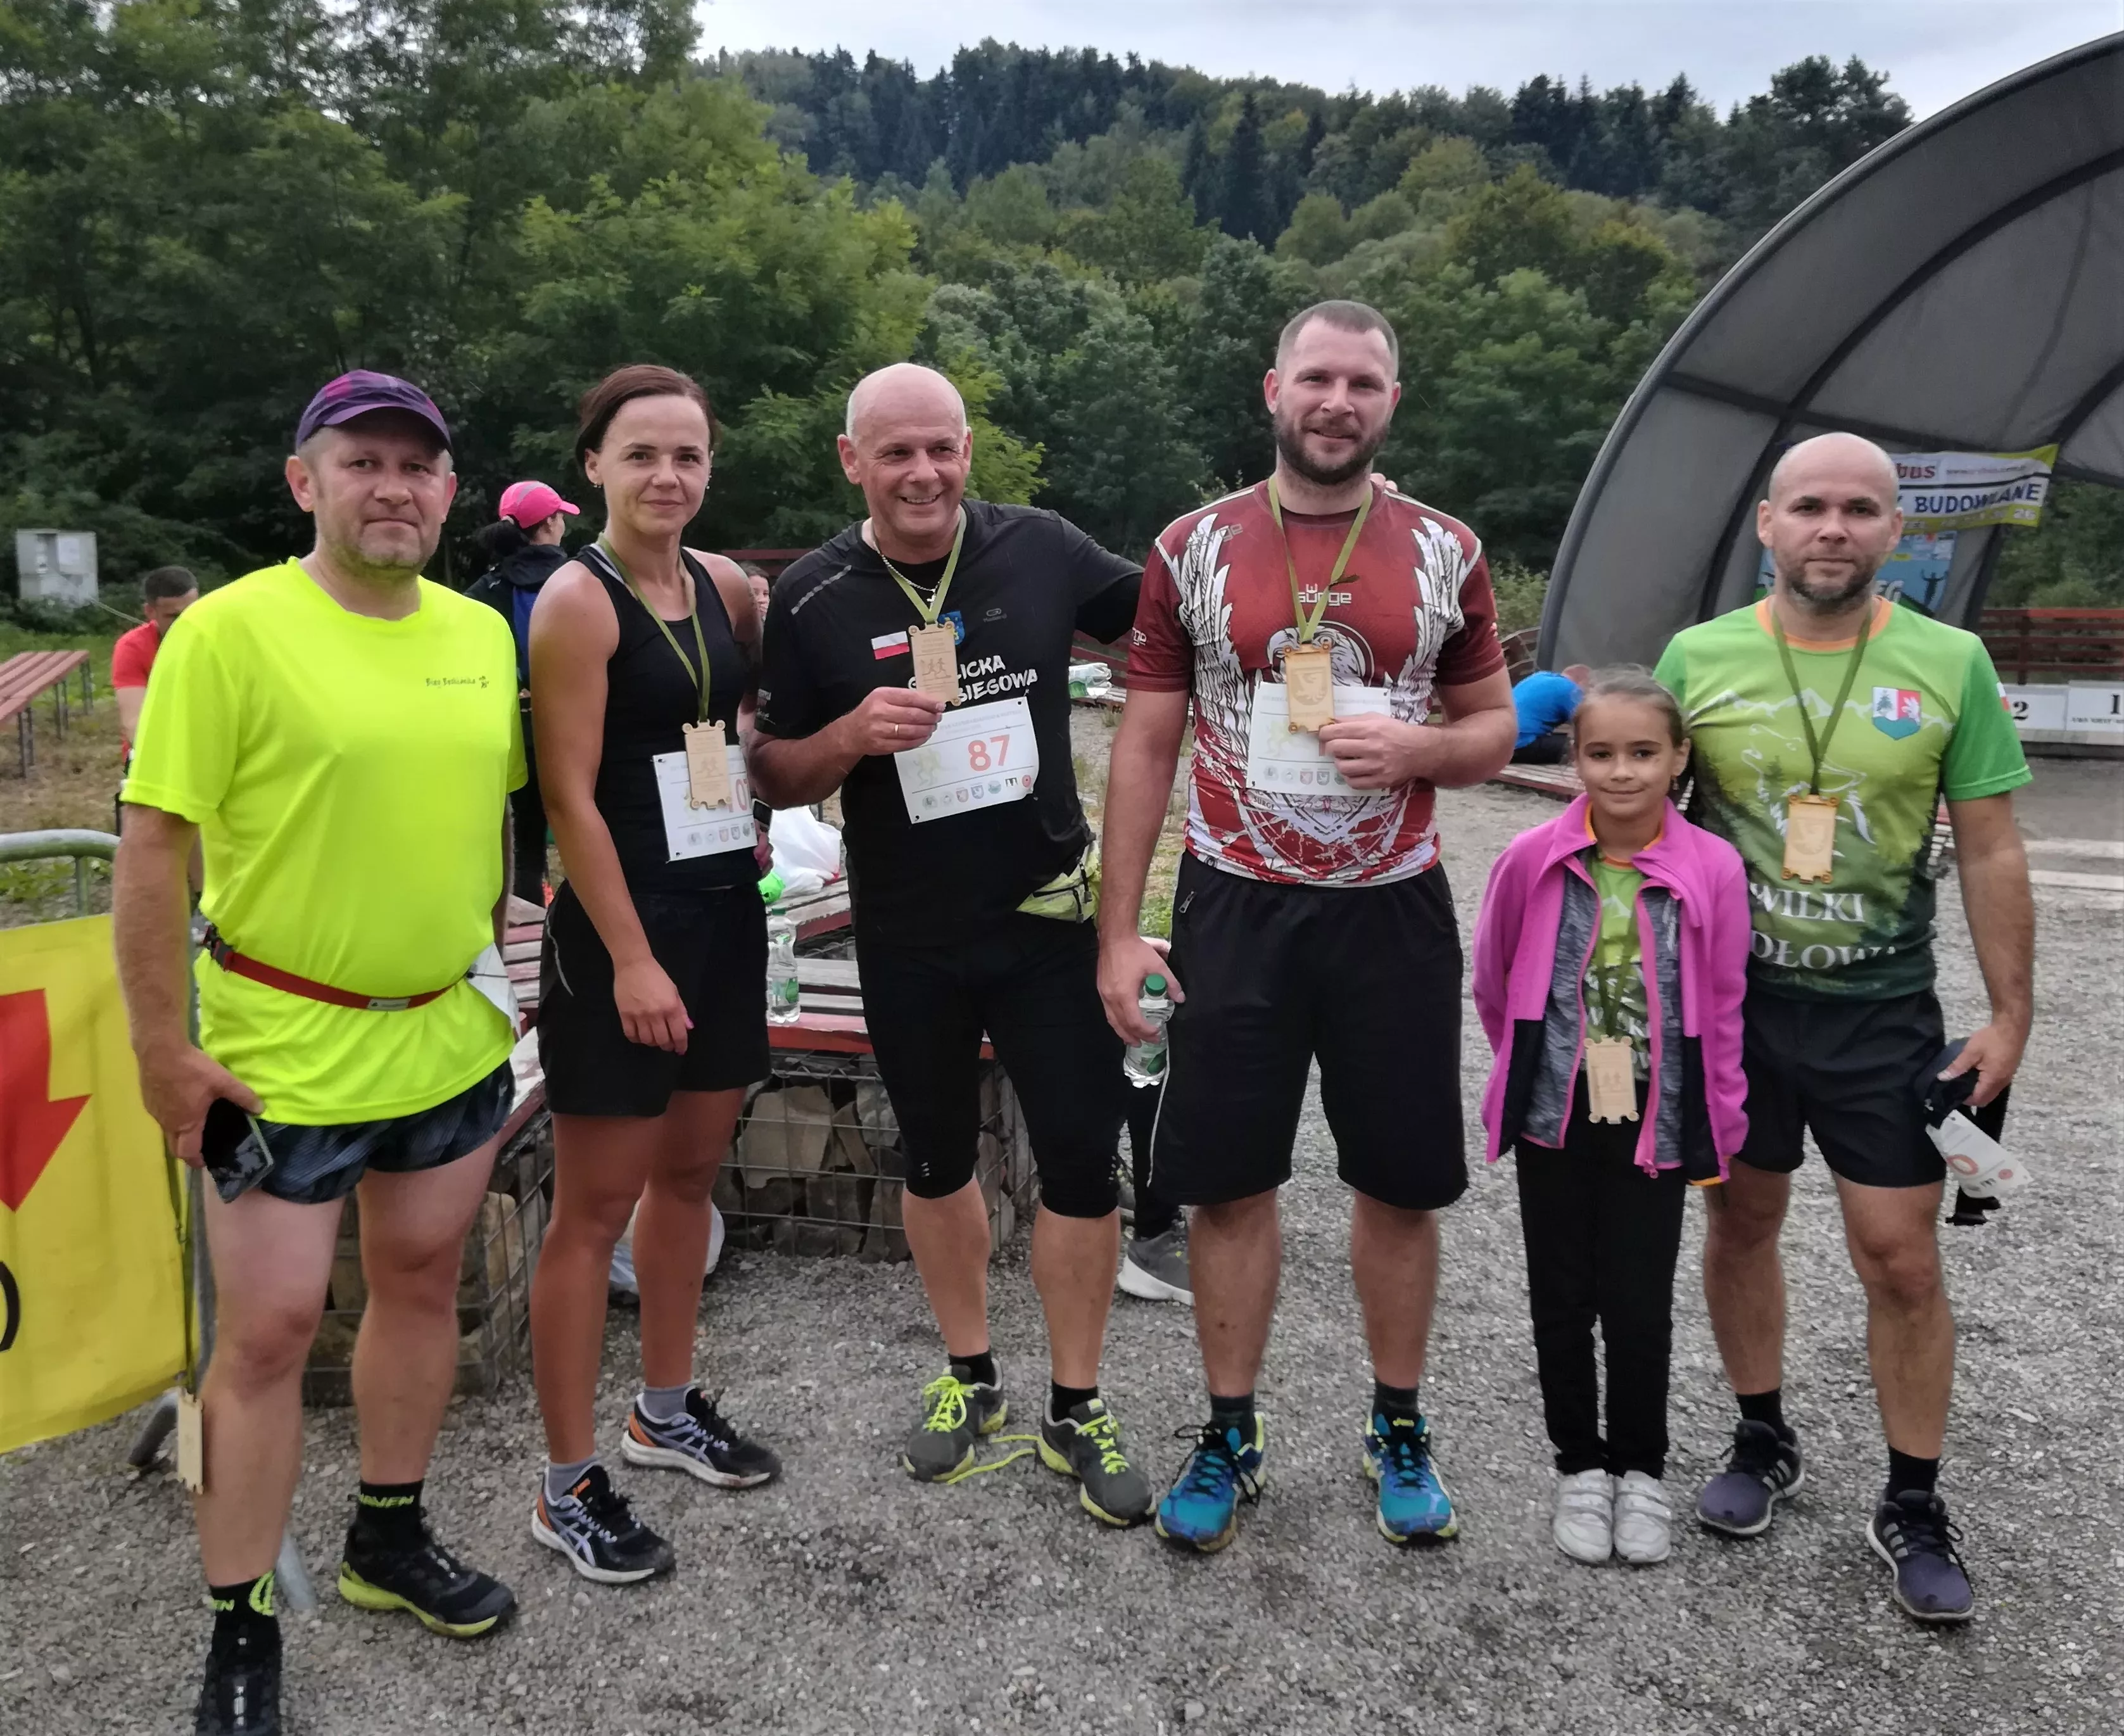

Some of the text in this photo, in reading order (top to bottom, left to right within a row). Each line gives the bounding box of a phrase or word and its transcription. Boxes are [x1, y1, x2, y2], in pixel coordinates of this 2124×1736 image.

[958, 655, 1006, 680] ICKA
[2013, 701, 2030, 721] 2
[2110, 694, 2121, 714] 1
[968, 733, 1010, 772] 87
[1750, 882, 1866, 923] WILKI
